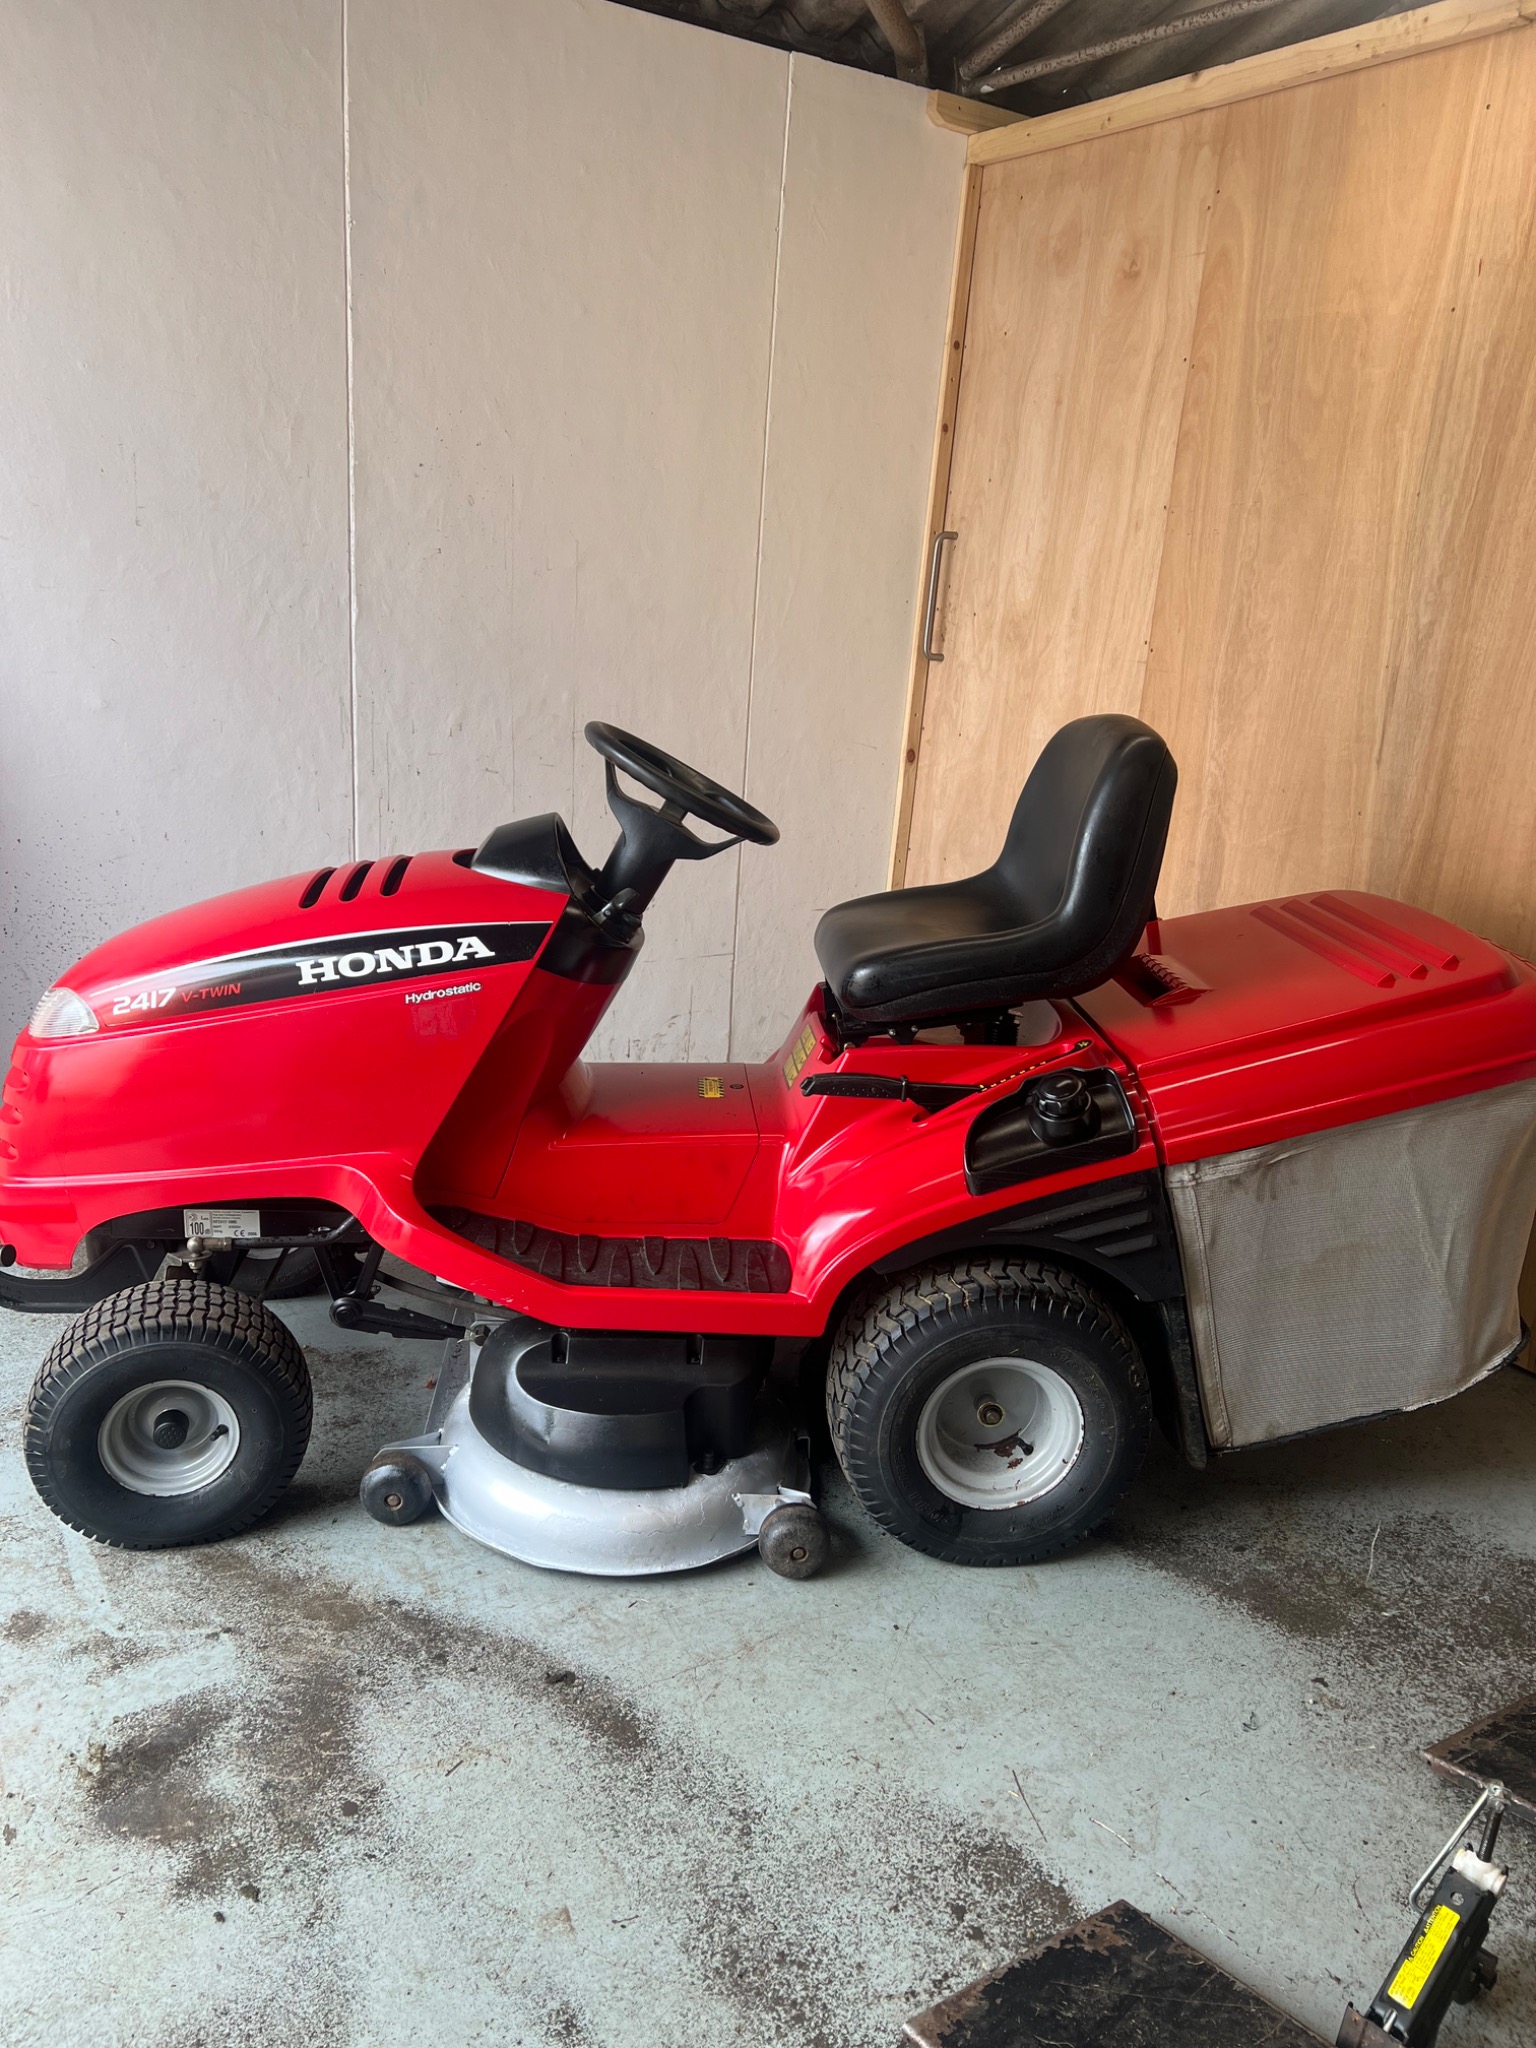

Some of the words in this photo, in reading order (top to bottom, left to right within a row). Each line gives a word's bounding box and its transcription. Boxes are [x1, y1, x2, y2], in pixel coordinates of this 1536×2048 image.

[295, 936, 496, 985] HONDA
[113, 987, 177, 1015] 2417
[181, 983, 241, 1003] V-TWIN
[404, 981, 482, 1005] Hydrostatic
[190, 1221, 204, 1235] 100
[1410, 1935, 1425, 1957] CAUTION
